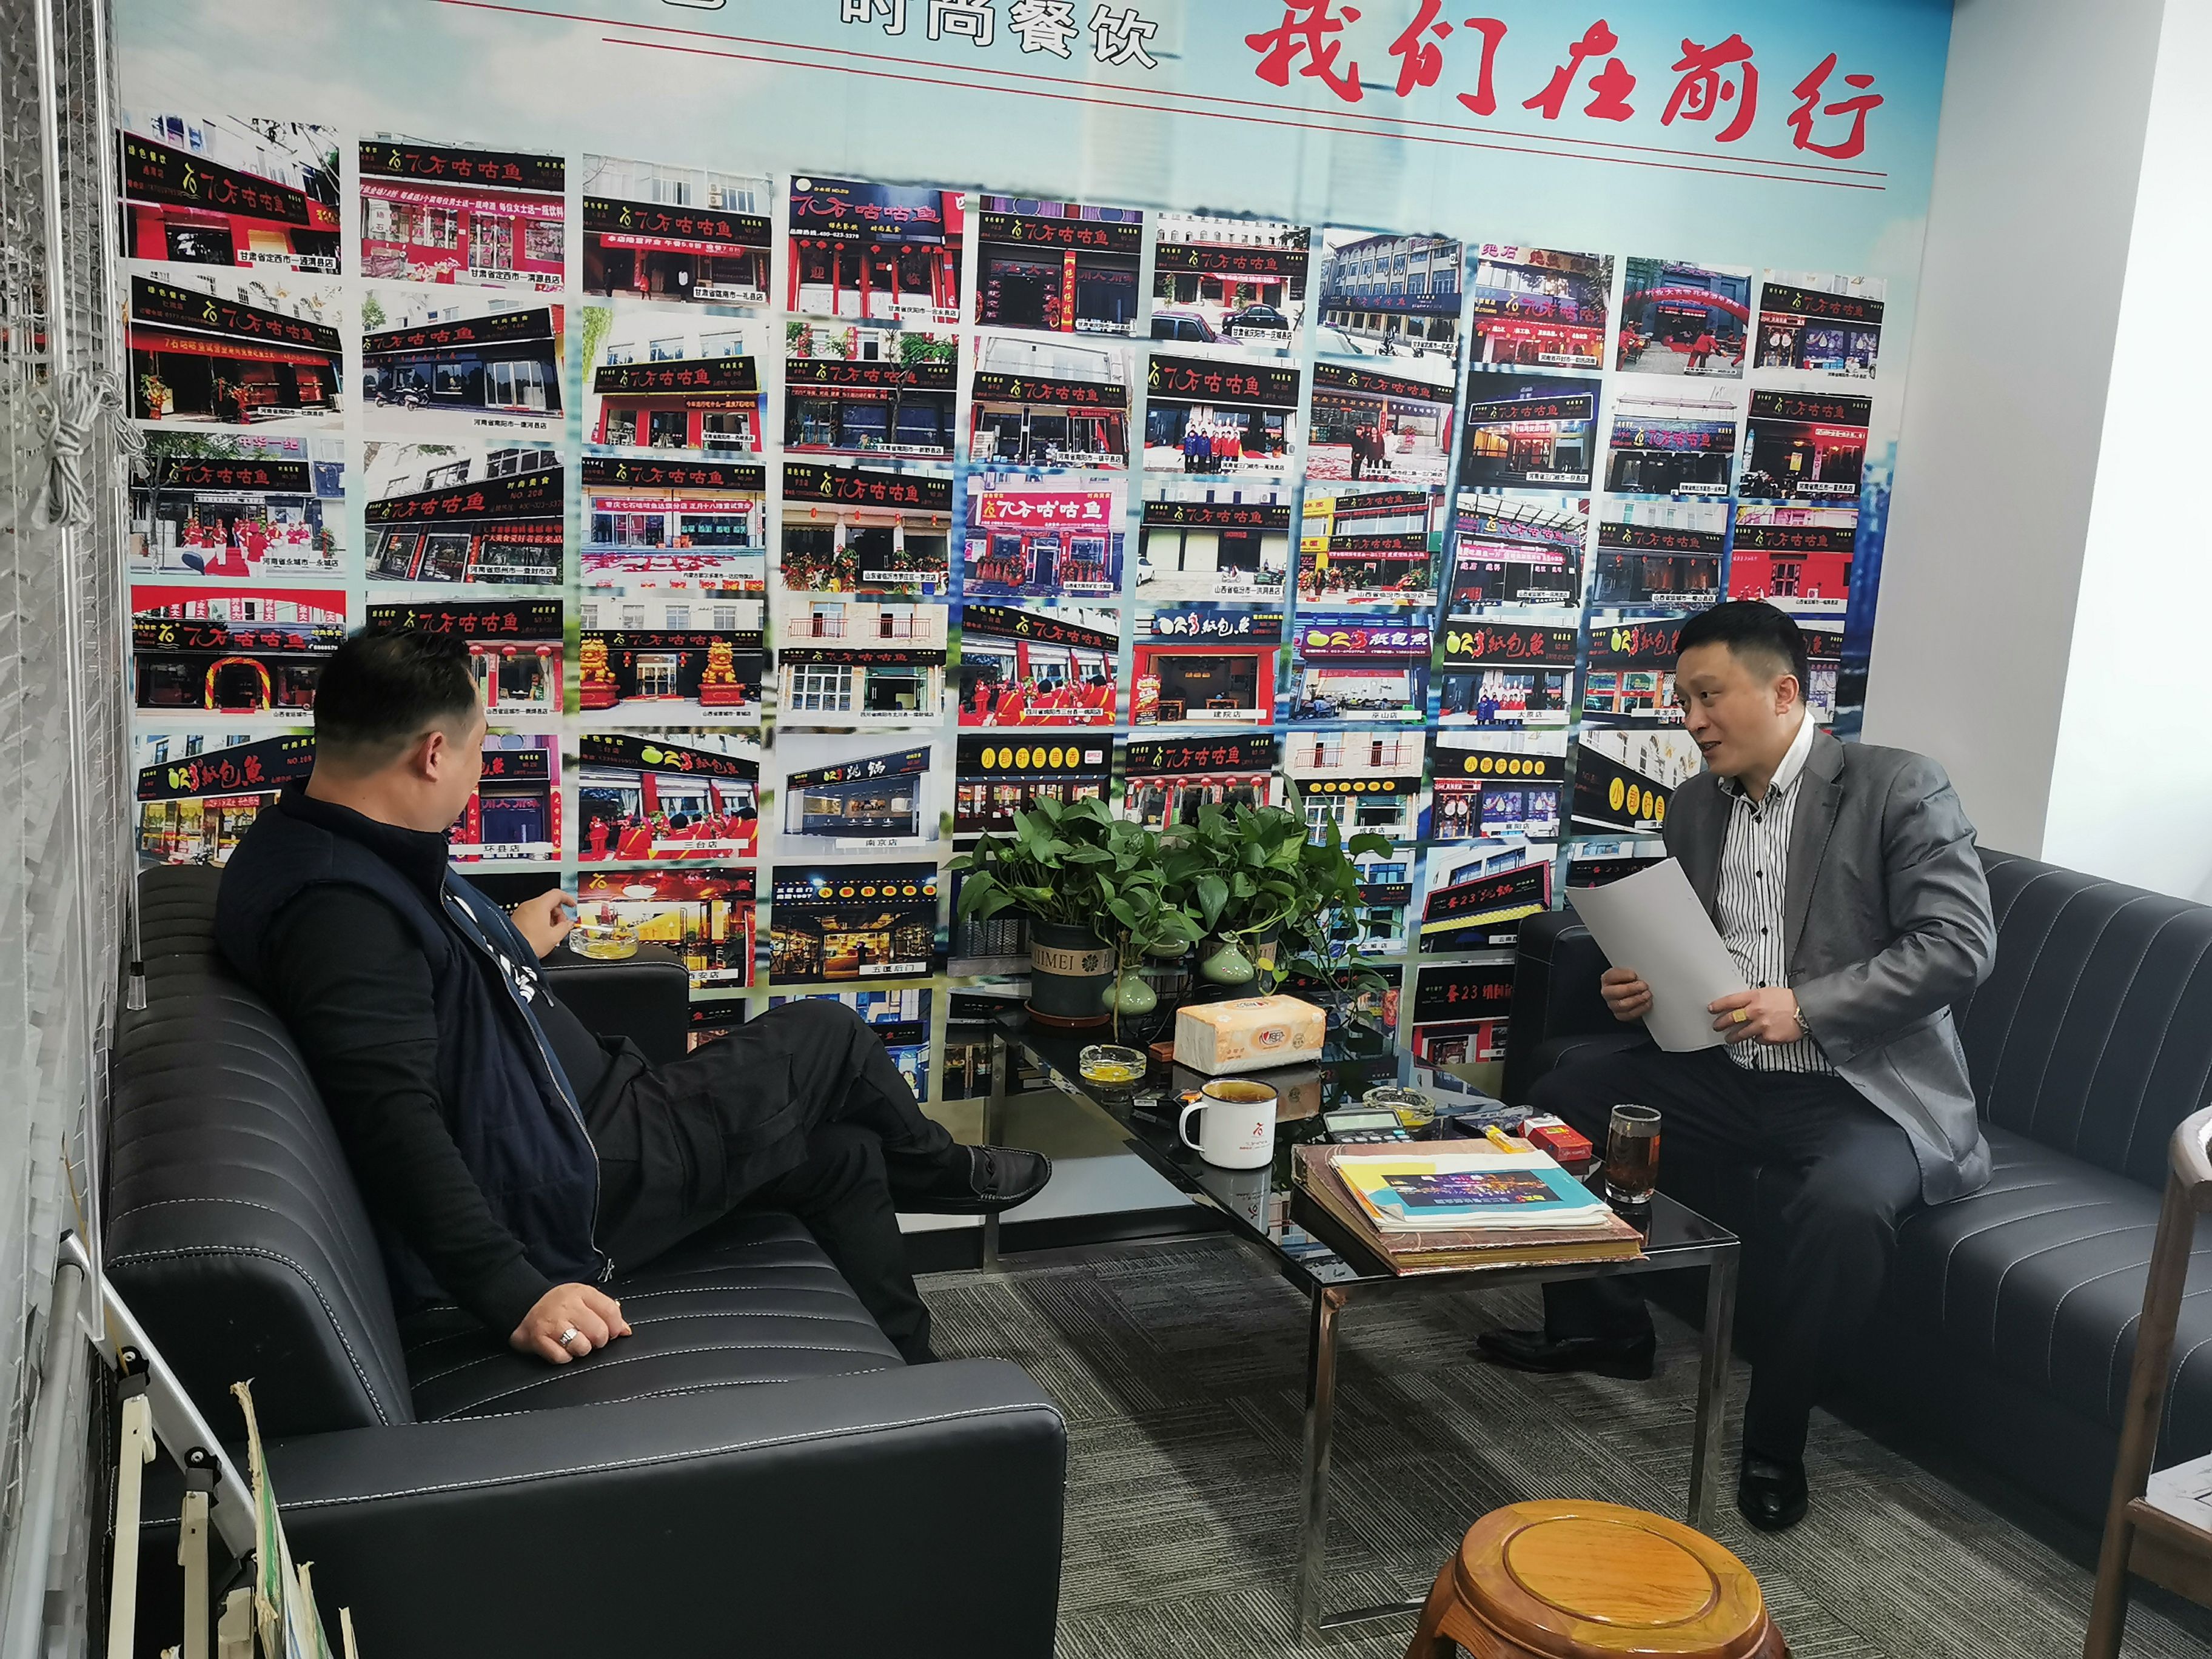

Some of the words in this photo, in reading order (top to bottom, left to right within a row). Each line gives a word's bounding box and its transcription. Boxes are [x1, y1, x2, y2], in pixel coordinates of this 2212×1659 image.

[840, 0, 1159, 69] 时尚餐饮
[1244, 0, 1884, 159] 我们在前行
